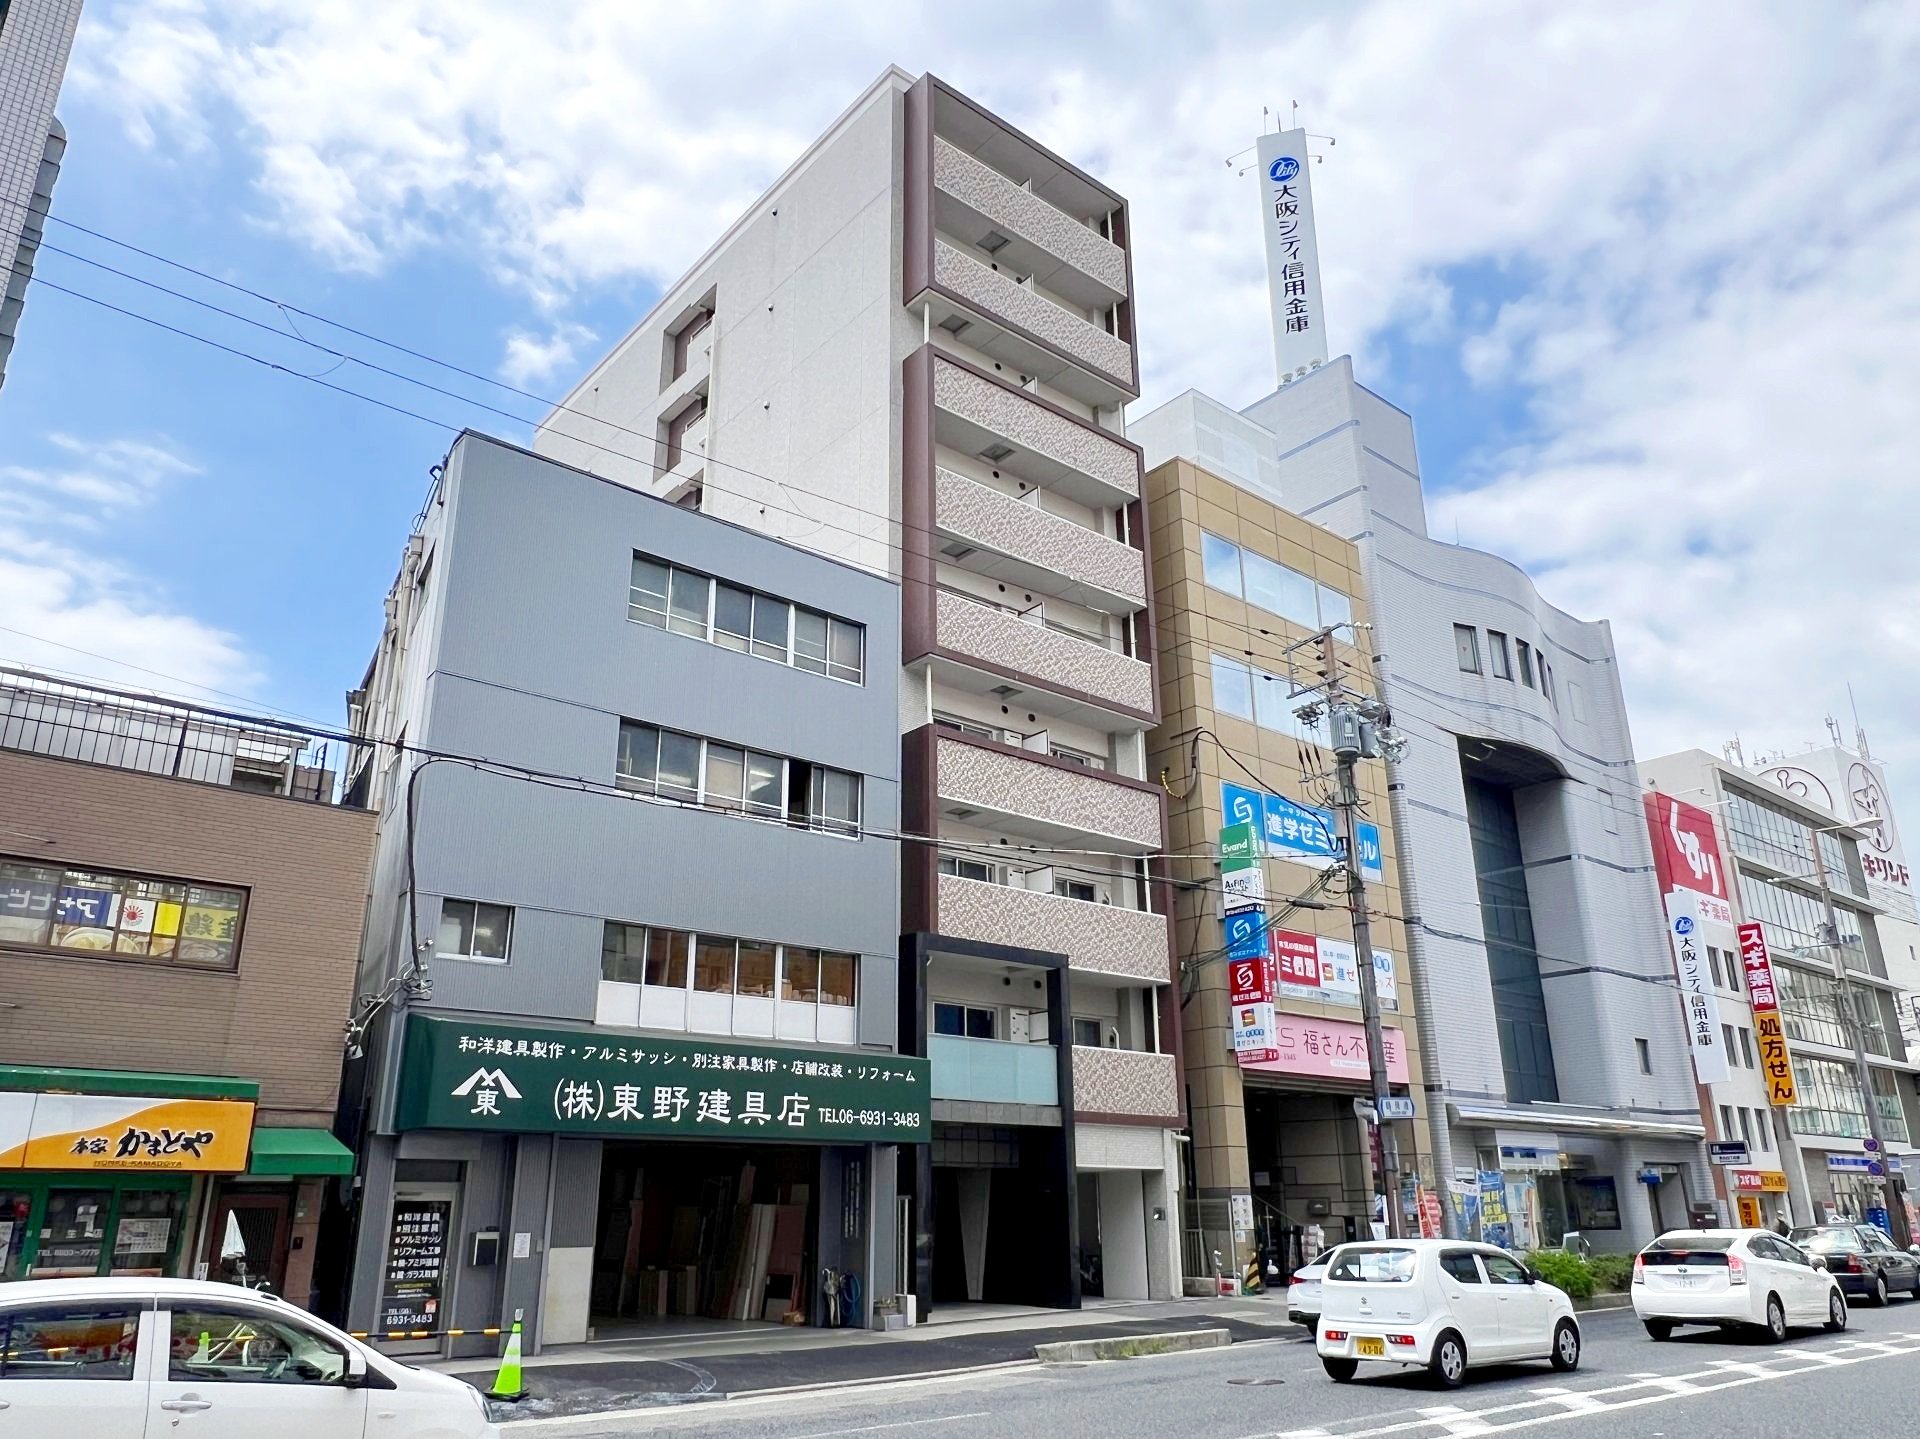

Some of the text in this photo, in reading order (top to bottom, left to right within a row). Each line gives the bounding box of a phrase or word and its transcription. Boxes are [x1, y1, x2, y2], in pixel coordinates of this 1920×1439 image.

[1273, 184, 1311, 335] 大阪シティ信用金庫
[1670, 801, 1719, 895] くすり
[1697, 899, 1731, 923] ギ薬局
[1678, 936, 1714, 1047] 大阪シティ信用金庫
[1739, 928, 1775, 1006] スギ薬局
[1303, 1029, 1396, 1063] 福さん不産
[1758, 1017, 1793, 1101] 処方せん
[470, 1087, 501, 1116] 東
[554, 1077, 921, 1129] (株)東野建具店 TEL06-6931-3483
[70, 1127, 215, 1159] 本家 かまどや
